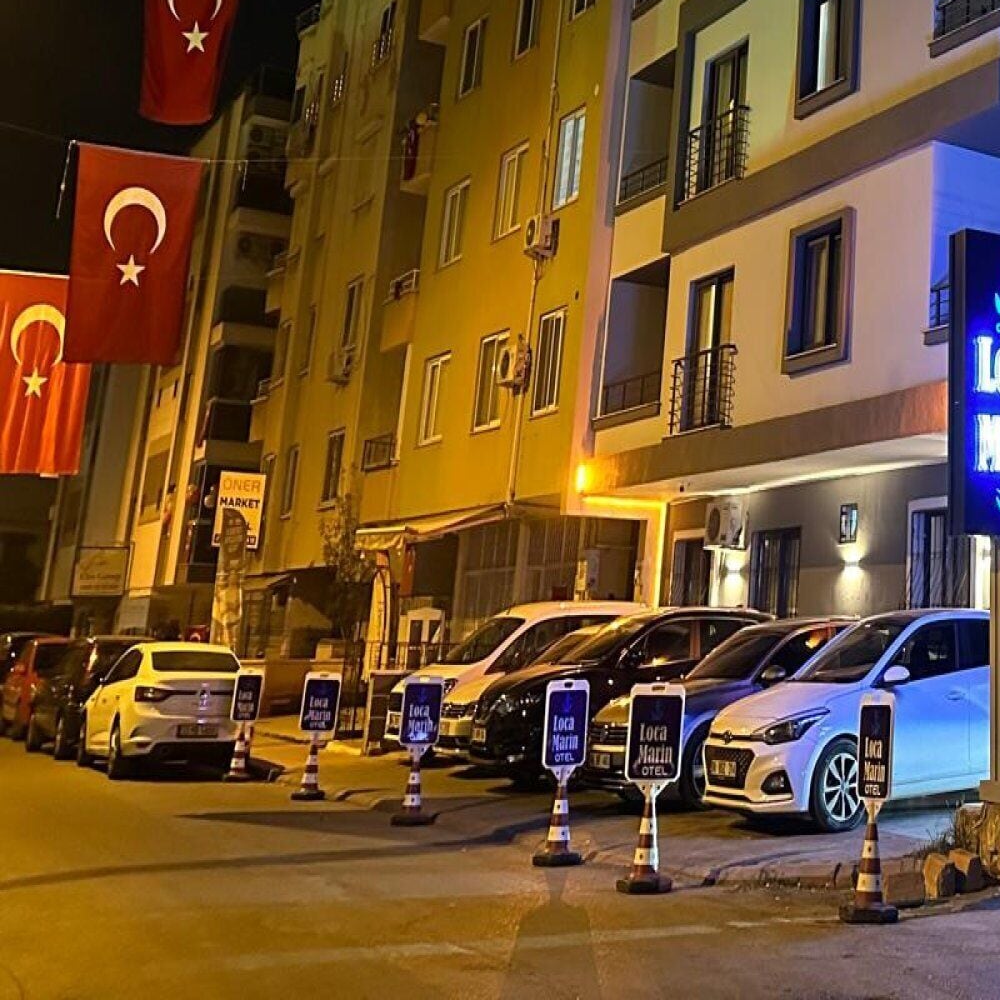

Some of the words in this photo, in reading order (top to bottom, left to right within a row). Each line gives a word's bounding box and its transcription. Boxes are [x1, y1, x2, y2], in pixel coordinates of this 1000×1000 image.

[219, 496, 261, 509] MARKET
[409, 704, 430, 718] Loca
[553, 714, 575, 732] Loca
[640, 722, 668, 743] Loca
[552, 733, 579, 752] Marin
[864, 736, 883, 759] Loca
[554, 752, 575, 763] OTEL
[639, 744, 673, 764] Marin
[641, 765, 669, 776] OTEL
[863, 760, 886, 782] Marin
[864, 784, 881, 796] OTEL
